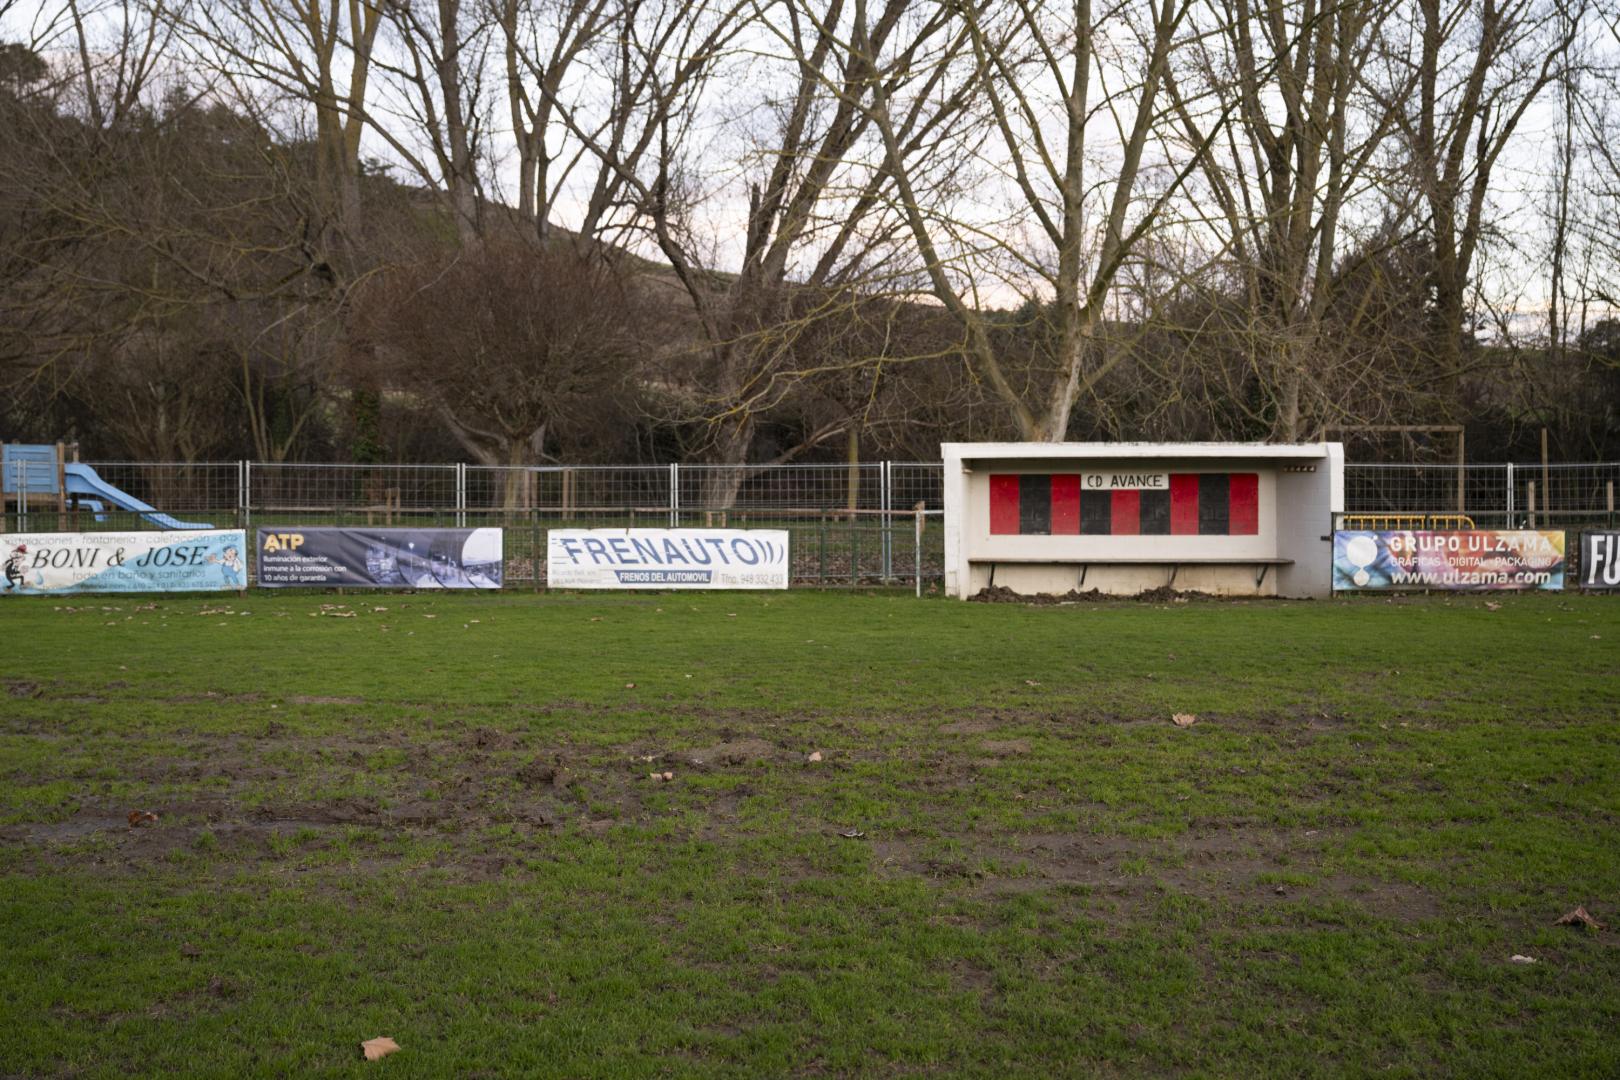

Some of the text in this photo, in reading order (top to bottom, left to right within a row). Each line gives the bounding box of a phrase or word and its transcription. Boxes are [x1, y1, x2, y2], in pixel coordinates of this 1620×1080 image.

[1087, 474, 1163, 488] CD AVANCE
[264, 533, 304, 552] ATP
[1391, 535, 1552, 552] GRUPO ULZAMA
[31, 548, 101, 568] BONI
[106, 547, 125, 567] &
[302, 555, 328, 563] exterior
[1449, 556, 1485, 566] DIGITAL
[1494, 556, 1552, 567] PACKAGING
[264, 574, 272, 582] 10
[620, 571, 709, 582] FRENOS DEL AUTOMOVIL
[1391, 569, 1552, 585] www.ulzama.com
